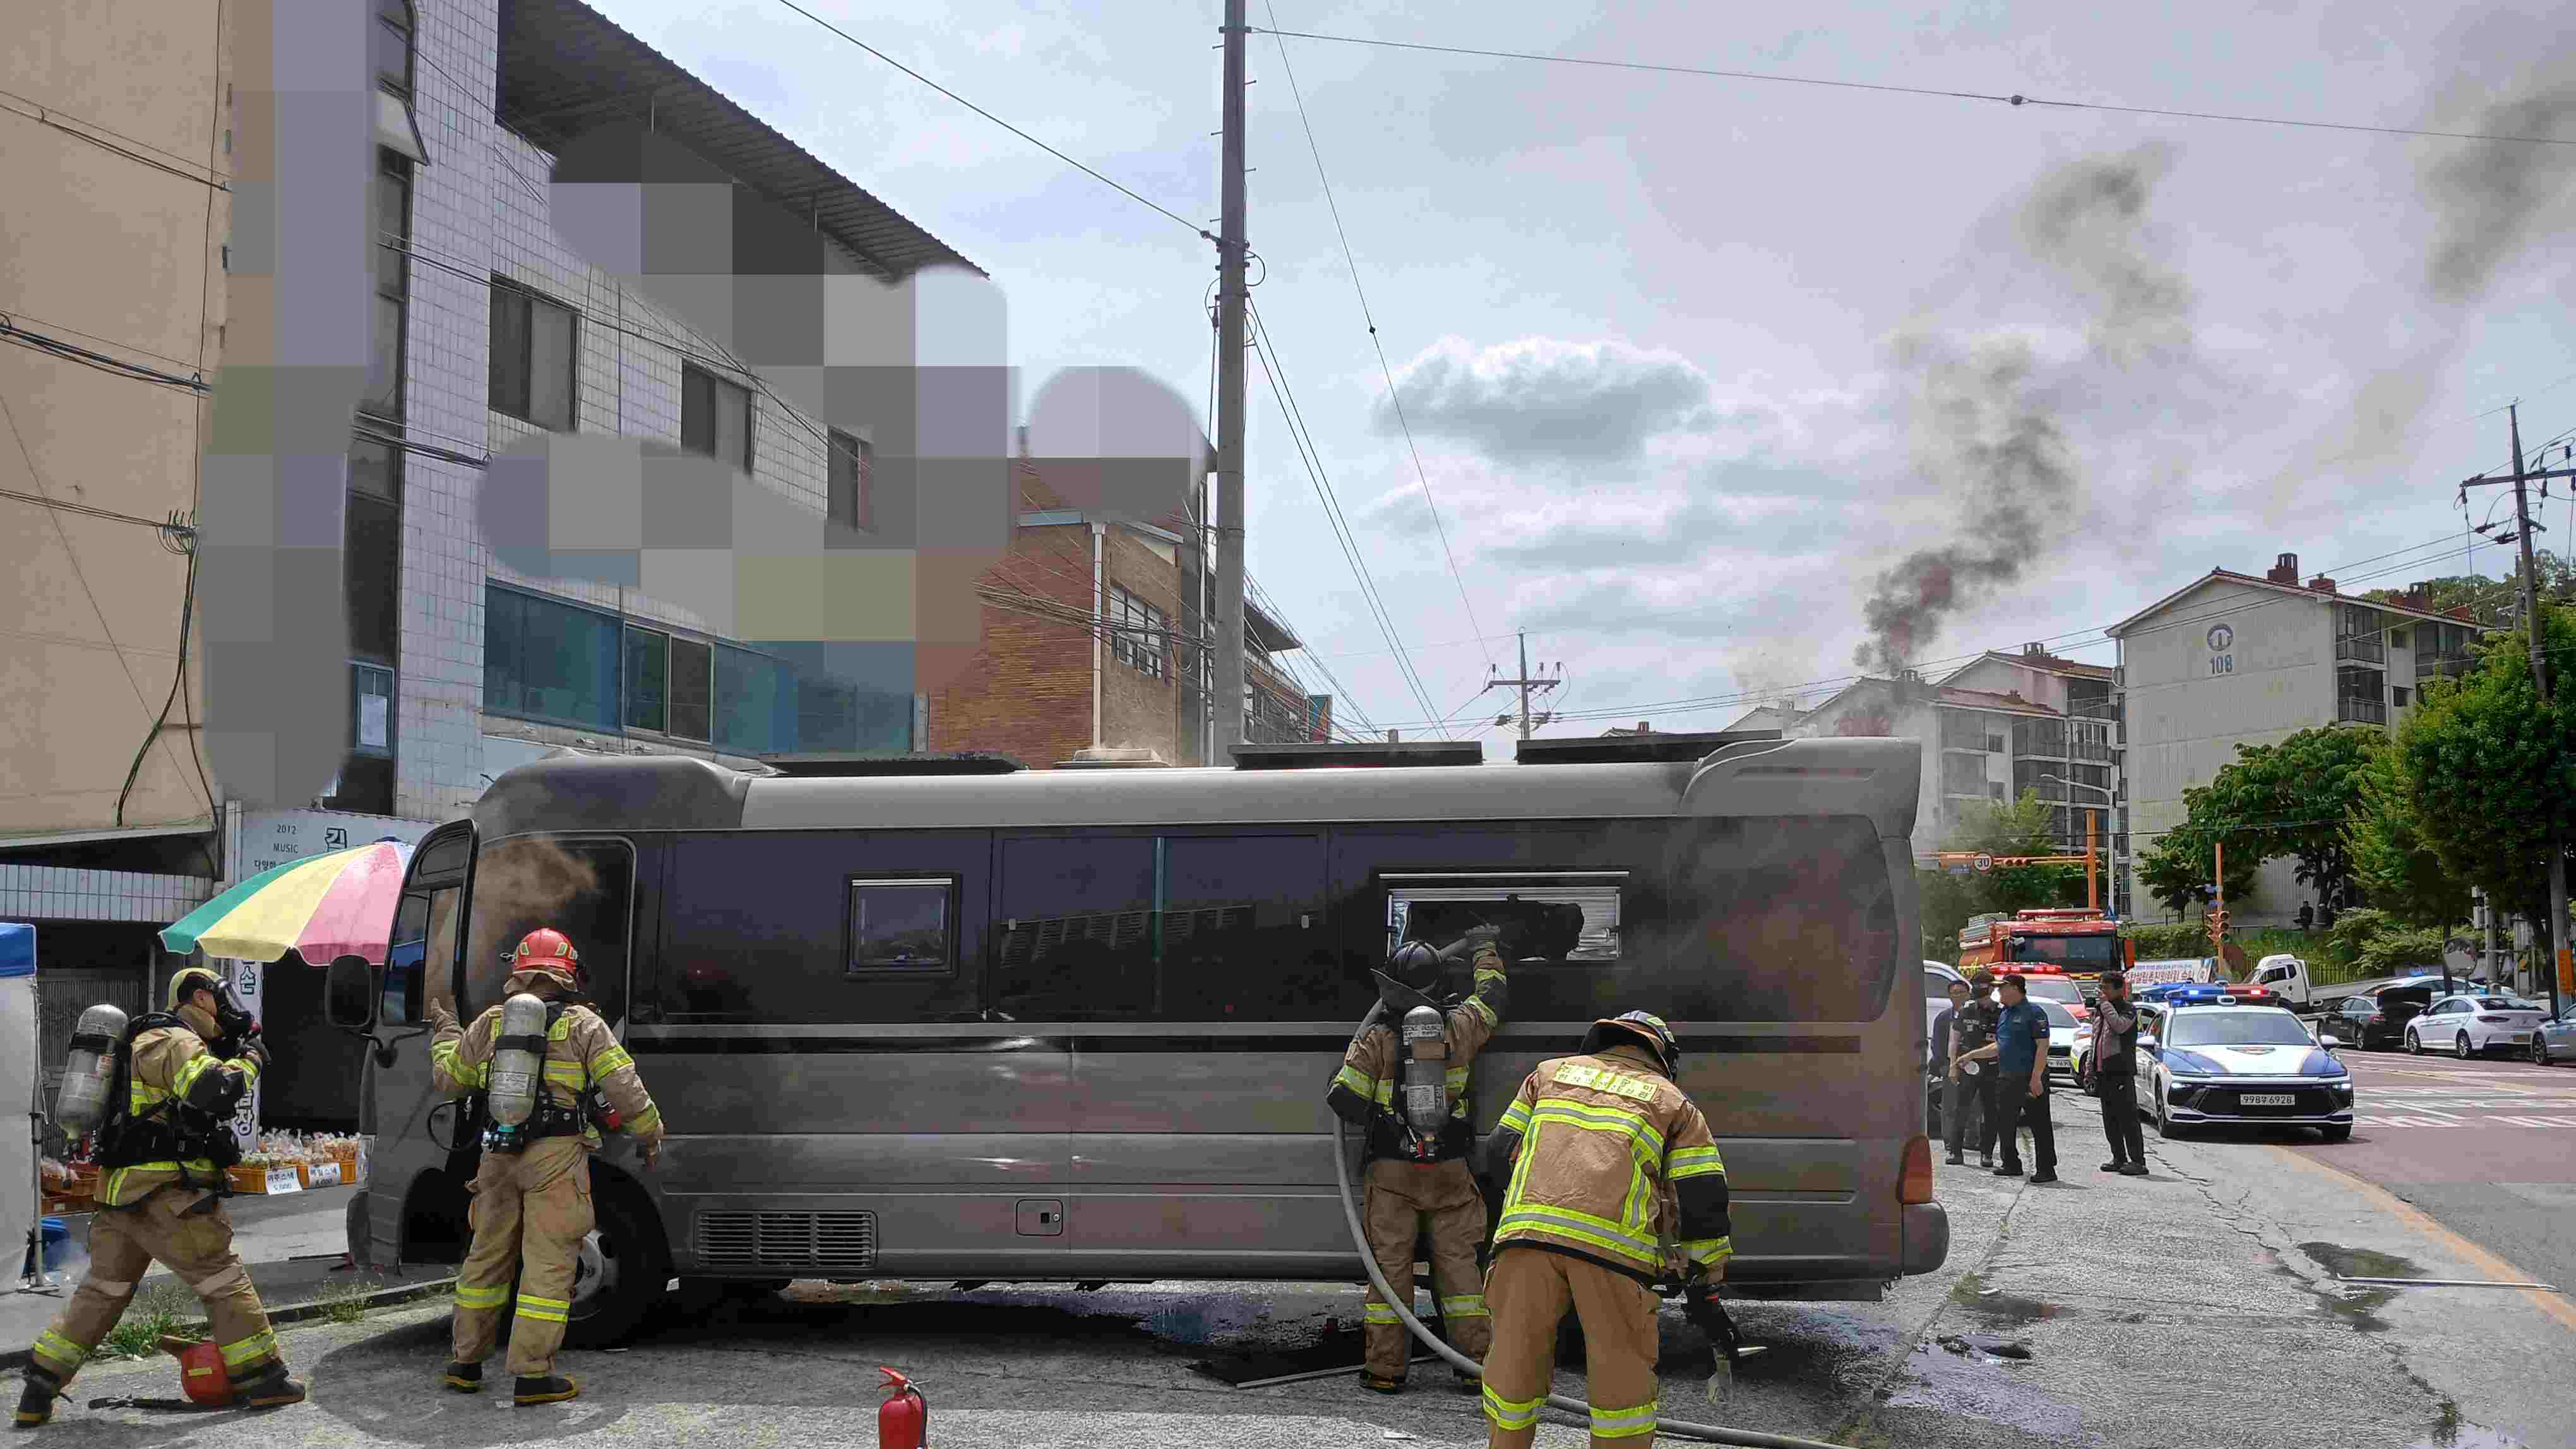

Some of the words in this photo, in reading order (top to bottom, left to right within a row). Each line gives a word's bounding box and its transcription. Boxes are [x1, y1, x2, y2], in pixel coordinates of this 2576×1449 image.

[2210, 654, 2233, 674] 108
[277, 824, 297, 835] 2012
[273, 842, 299, 854] MUSIC
[1977, 858, 1990, 868] 30
